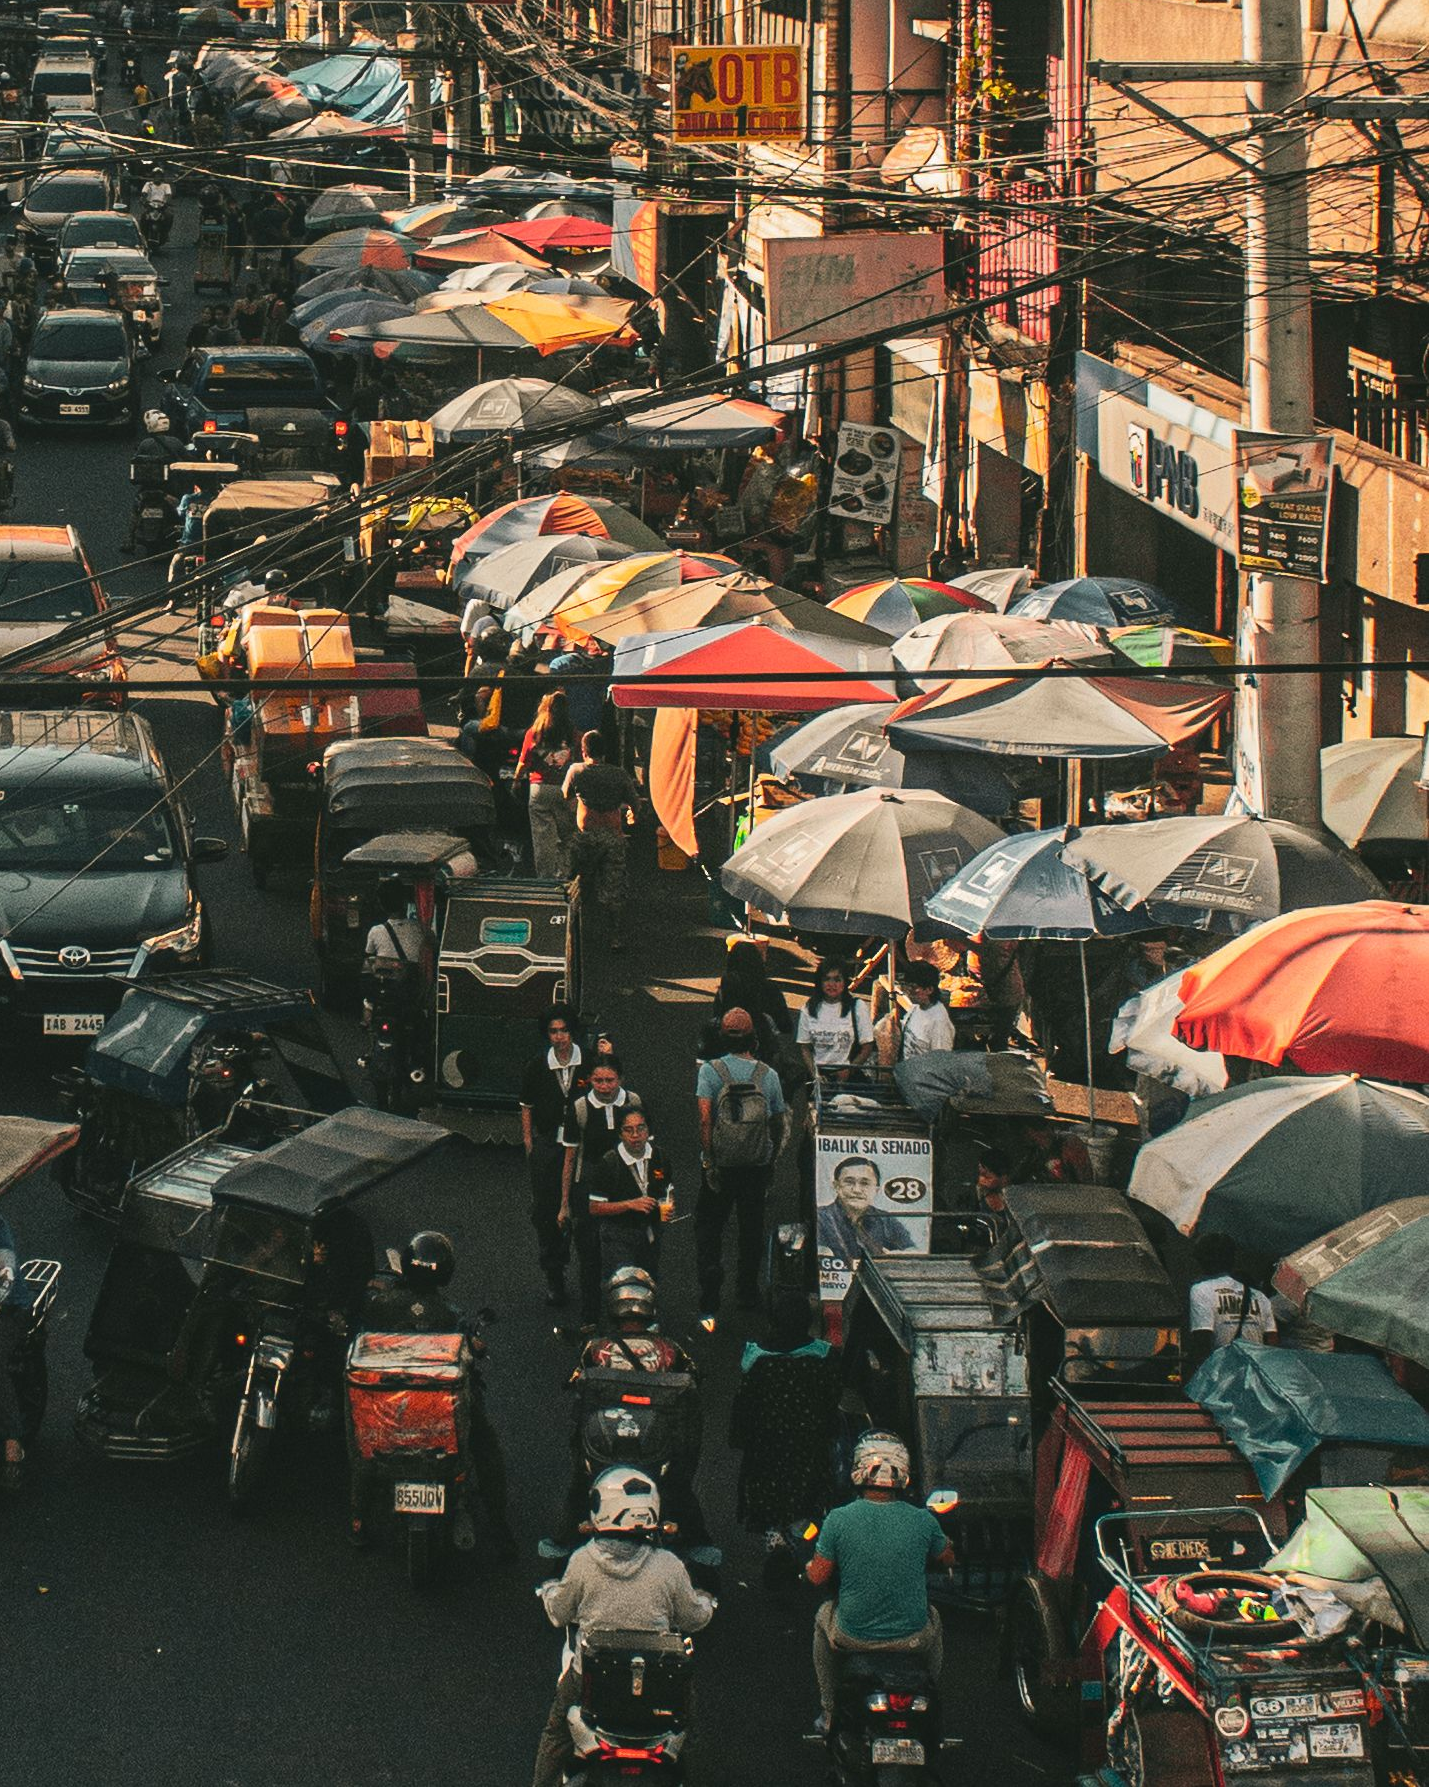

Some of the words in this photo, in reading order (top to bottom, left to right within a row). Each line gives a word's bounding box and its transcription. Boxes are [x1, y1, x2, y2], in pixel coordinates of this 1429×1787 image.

[718, 54, 800, 105] OTB
[1147, 427, 1199, 520] PNB
[1269, 501, 1296, 510] GREAT
[1279, 512, 1298, 520] LOW
[1298, 514, 1323, 523] RATES
[45, 1018, 67, 1031] IAB
[73, 1018, 104, 1031] 2445
[818, 1137, 860, 1153] IBALIK
[862, 1139, 879, 1154] SA
[881, 1140, 931, 1155] SENADO
[890, 1181, 922, 1200] 28
